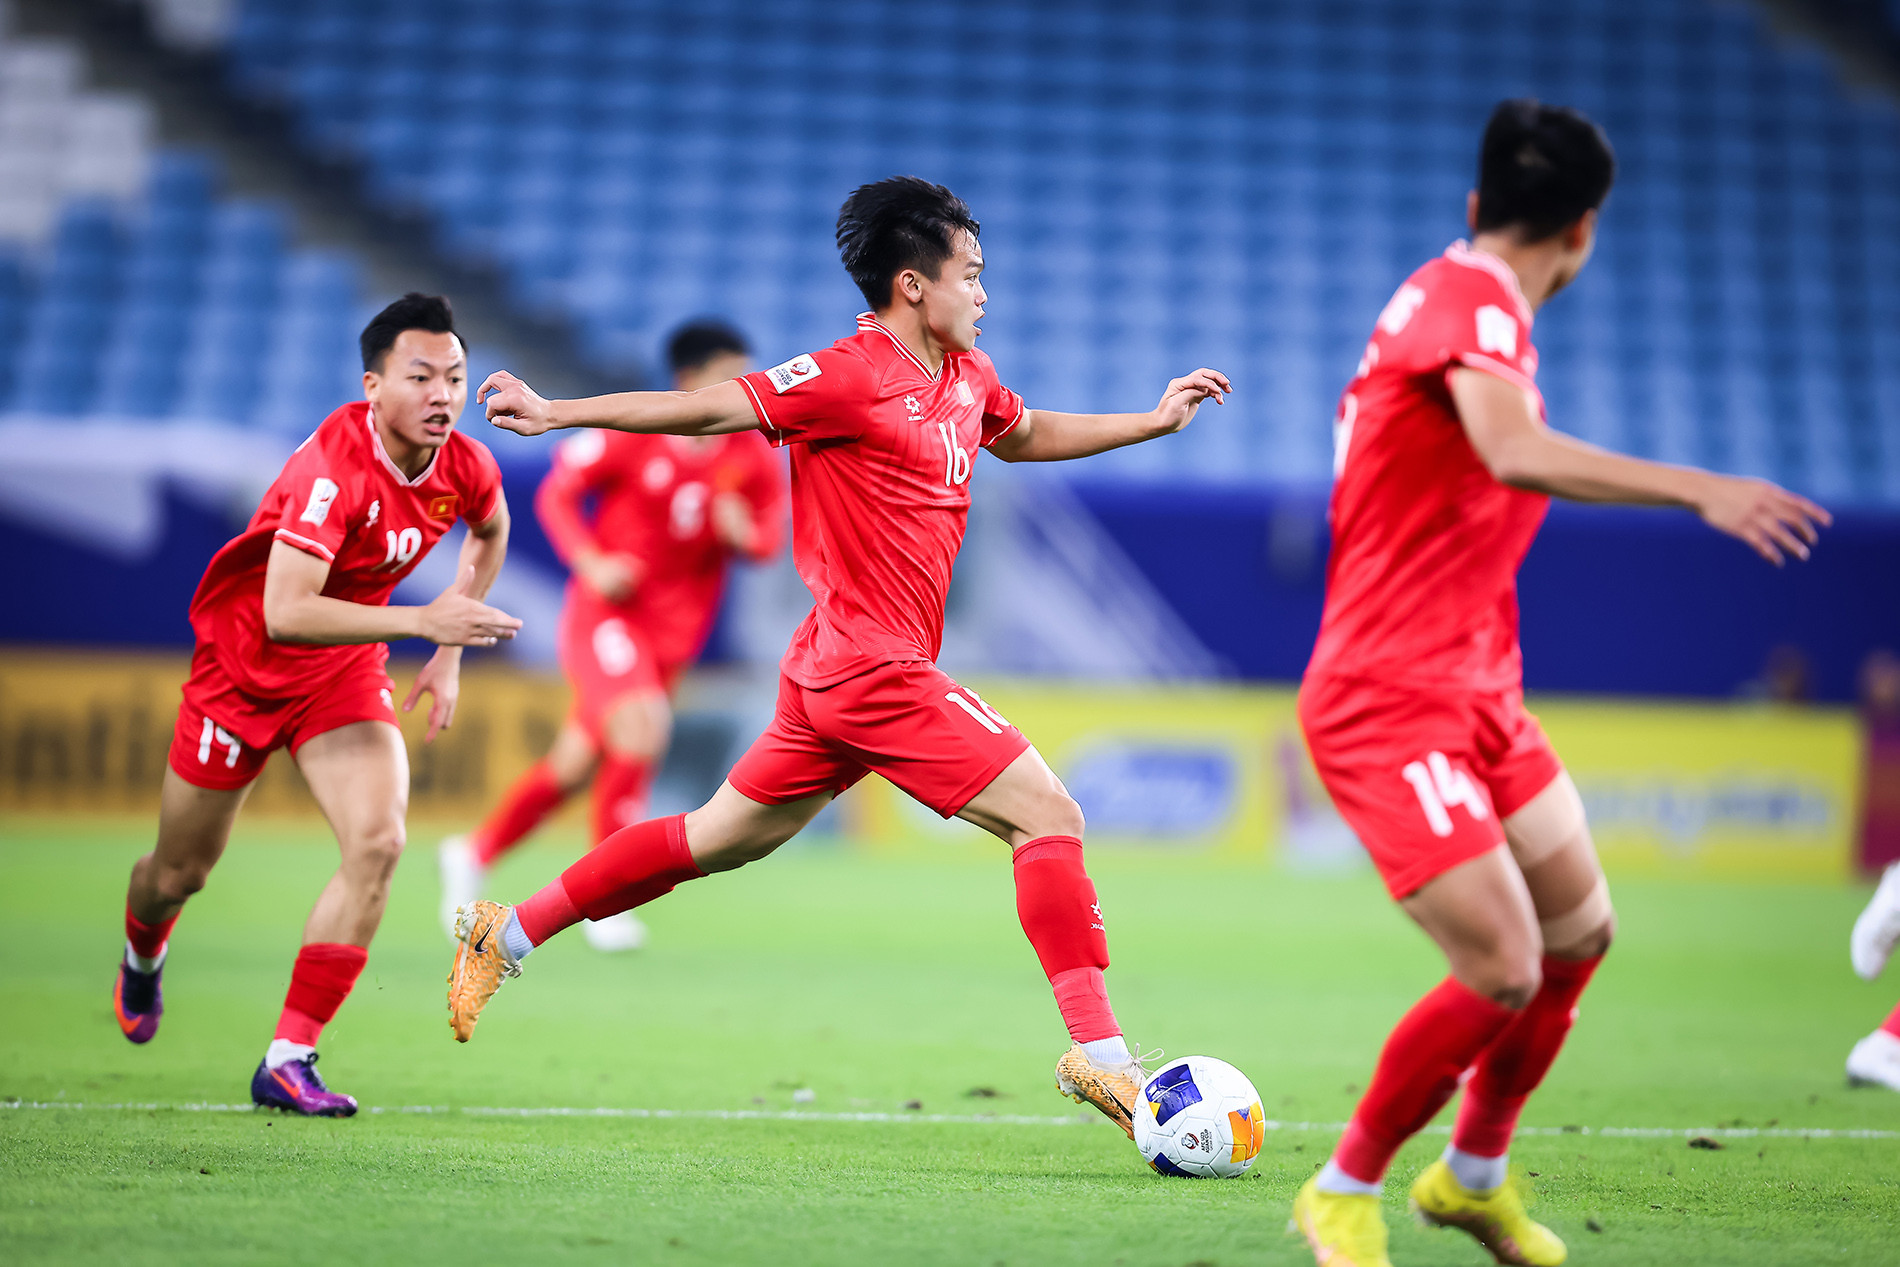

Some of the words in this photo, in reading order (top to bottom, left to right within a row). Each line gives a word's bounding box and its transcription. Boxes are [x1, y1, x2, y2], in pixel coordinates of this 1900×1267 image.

[938, 420, 970, 487] 16
[371, 527, 423, 574] 19
[197, 716, 241, 768] 19
[1401, 750, 1489, 838] 14
